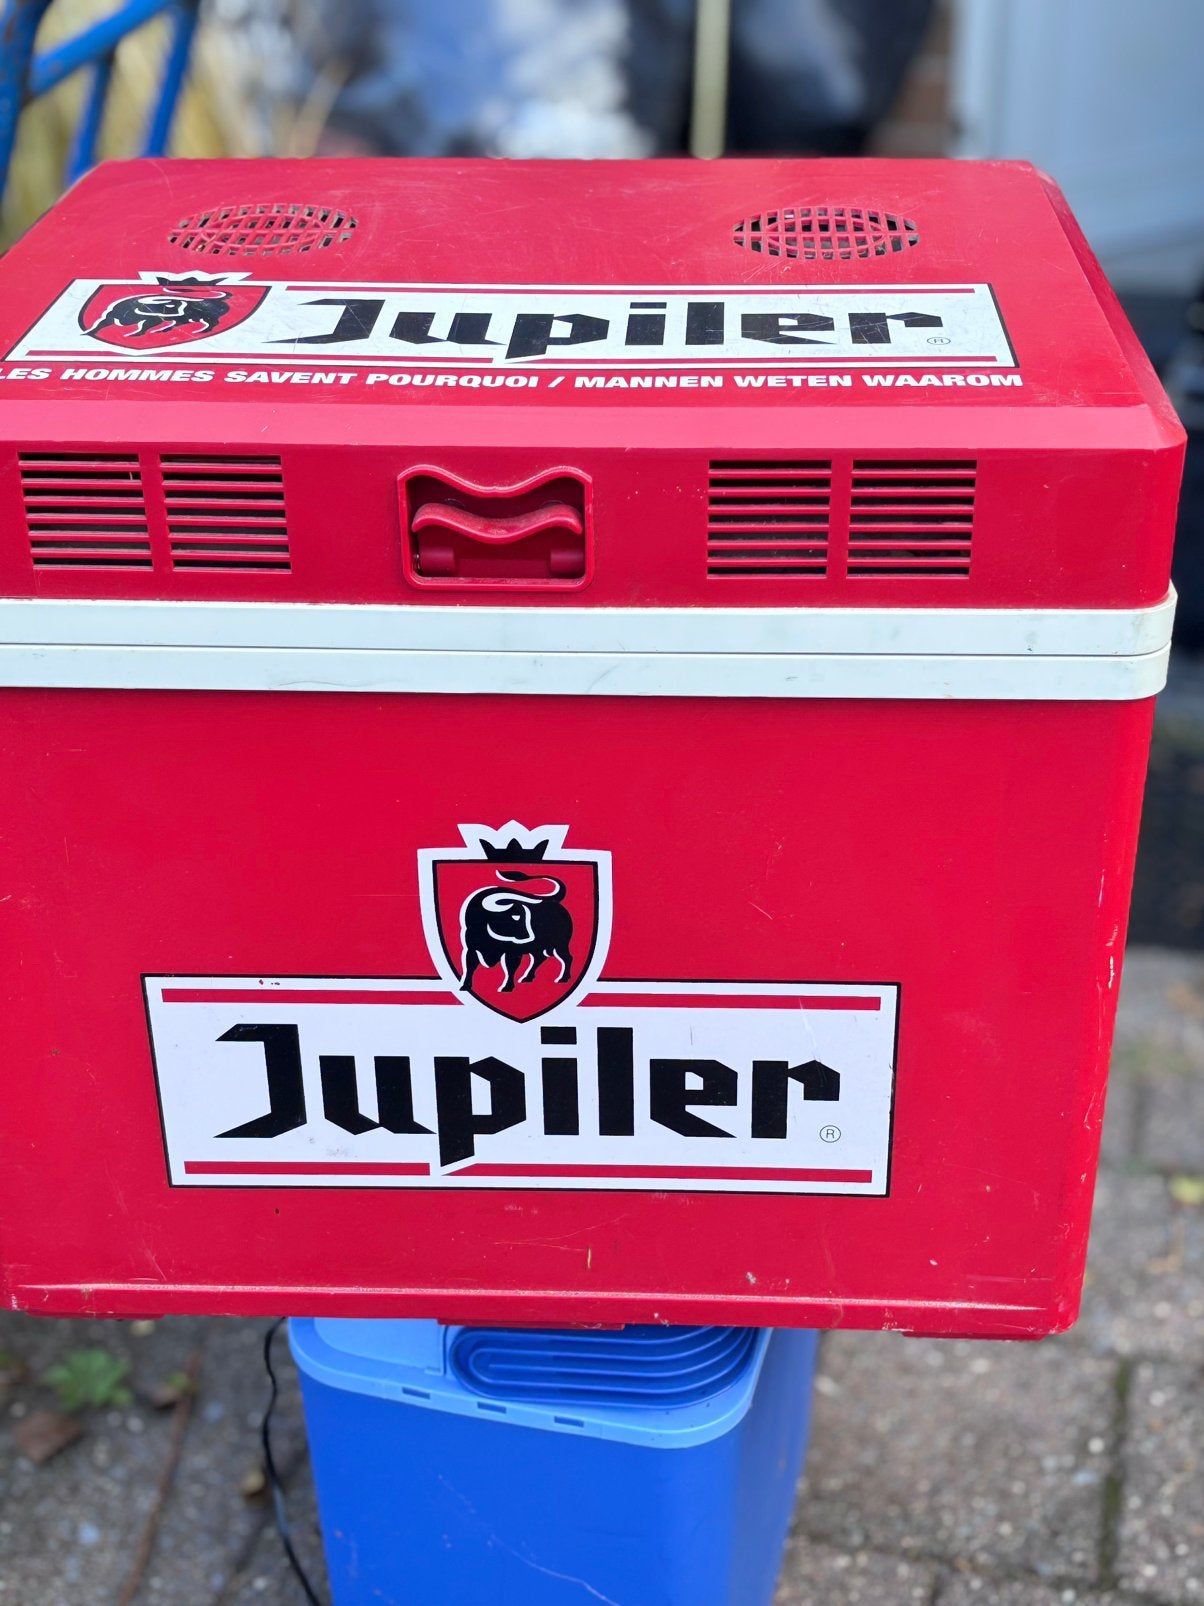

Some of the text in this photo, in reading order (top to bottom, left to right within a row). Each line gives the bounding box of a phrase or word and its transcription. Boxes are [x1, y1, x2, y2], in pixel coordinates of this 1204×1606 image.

[262, 299, 943, 360] Jupiler
[60, 368, 214, 383] HOMMES
[225, 370, 358, 385] SAVENT
[366, 373, 540, 388] POURQUOI
[574, 375, 724, 388] MANNEN
[735, 375, 852, 388] WETEN
[862, 374, 1023, 387] WAAROM
[213, 1023, 841, 1167] Jupiler
